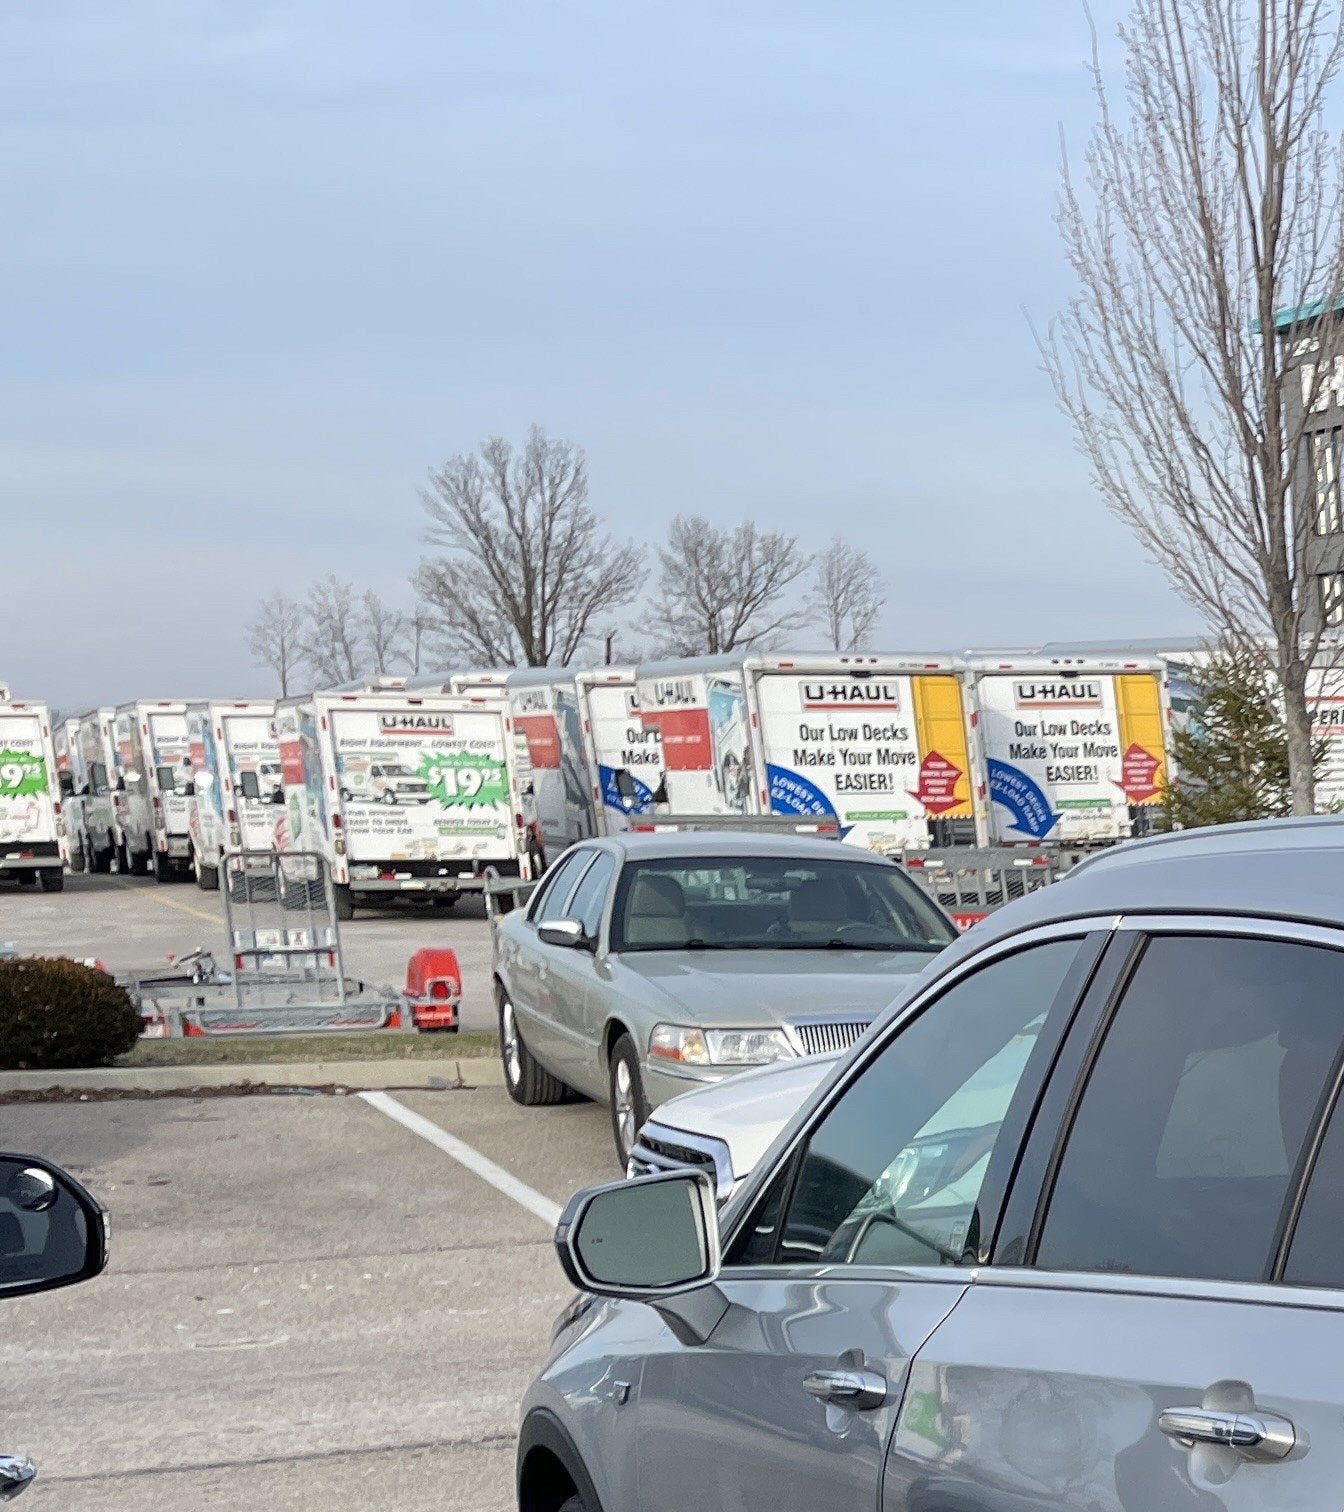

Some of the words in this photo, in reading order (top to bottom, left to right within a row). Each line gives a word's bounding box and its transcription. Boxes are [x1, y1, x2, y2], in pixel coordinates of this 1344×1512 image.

[804, 684, 895, 700] U-HAUL
[1018, 684, 1099, 699] U-HAUL
[382, 717, 450, 728] U-HAUL
[1015, 721, 1037, 737] Our
[1041, 720, 1066, 736] Low
[1070, 720, 1112, 736] Decks
[799, 724, 825, 742] Our
[829, 725, 857, 741] Low
[863, 724, 909, 741] Decks
[622, 750, 660, 766] Make
[793, 750, 836, 766] Make
[839, 749, 872, 766] Your
[877, 749, 916, 766] Move
[1009, 744, 1048, 760] Make
[1050, 743, 1080, 759] Your
[1083, 743, 1119, 758] Move
[835, 773, 895, 791] EASIER!
[990, 768, 1028, 792] LOWEST
[1046, 765, 1099, 782] EASIER!
[773, 775, 814, 802] LOWEST
